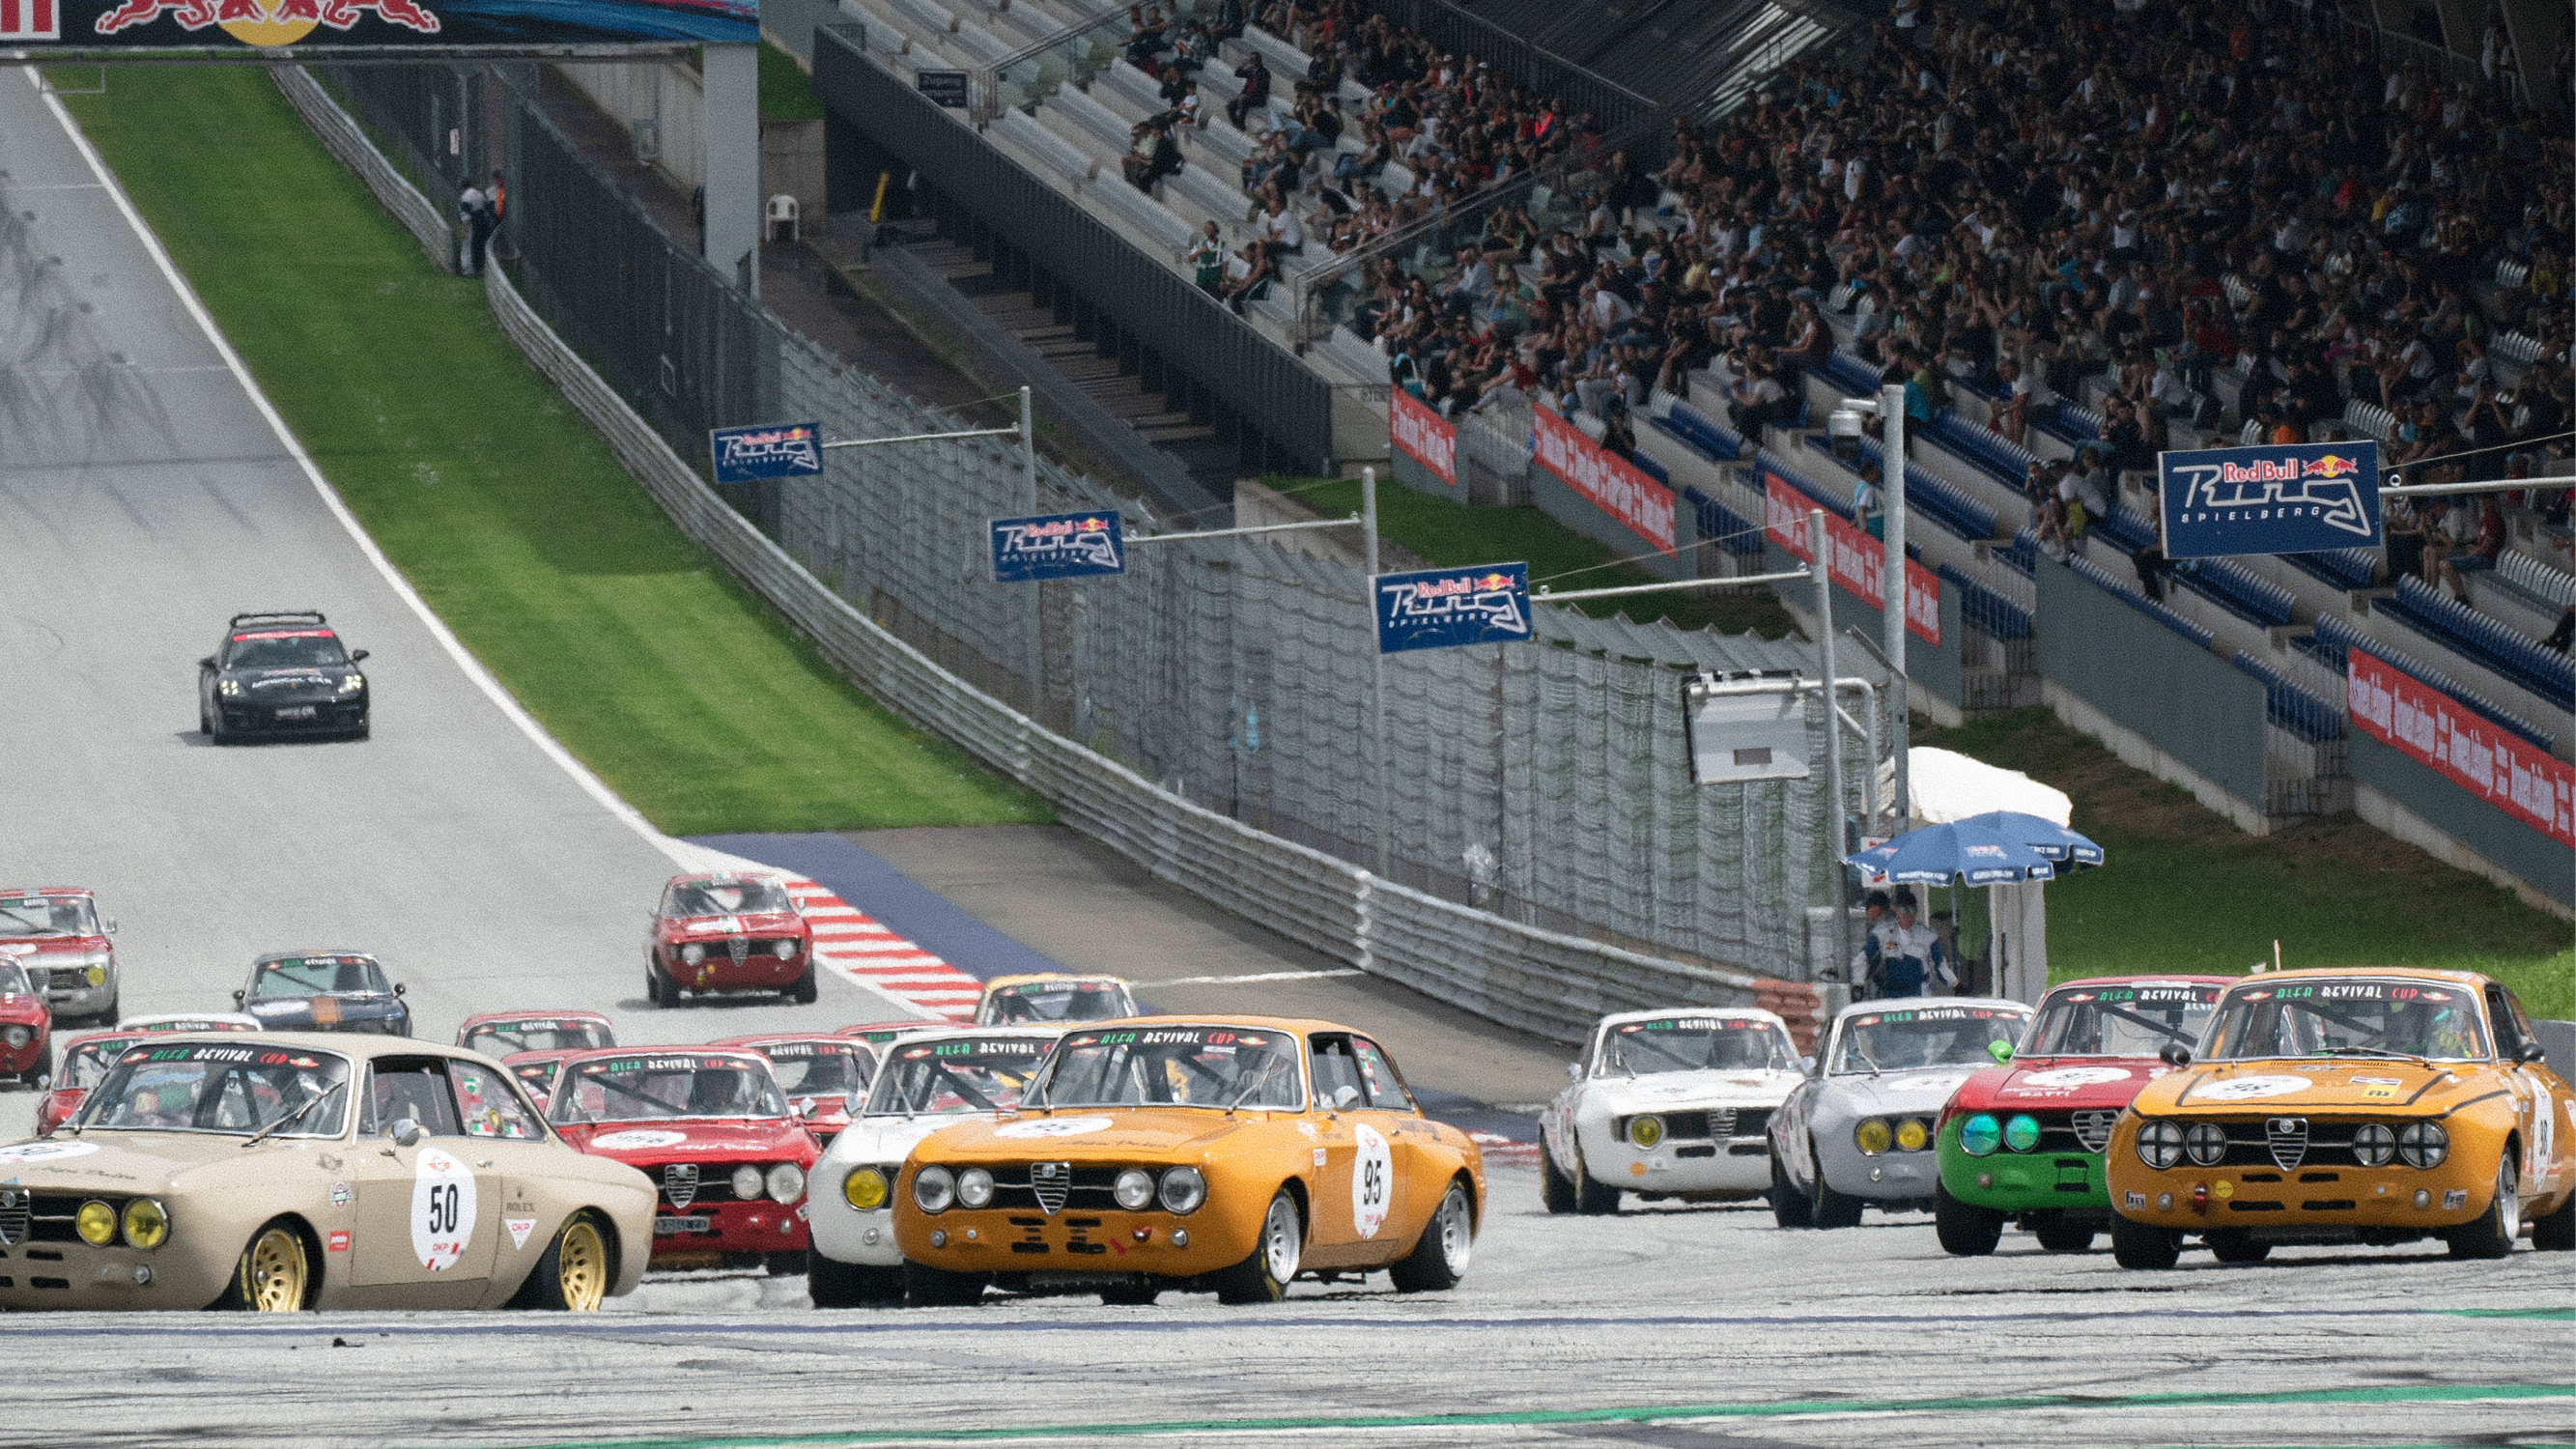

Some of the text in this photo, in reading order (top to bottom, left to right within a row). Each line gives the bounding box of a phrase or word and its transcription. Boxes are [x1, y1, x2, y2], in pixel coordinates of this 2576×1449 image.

[2223, 458, 2298, 483] Red Bull
[2172, 464, 2371, 537] Ring
[2181, 506, 2320, 524] SPIELBERG
[1418, 577, 1472, 598] Red Bull
[2099, 990, 2134, 1002] ALFA
[2140, 989, 2197, 1002] REVIVAL
[2276, 985, 2419, 1000] ALFA REVIVAL CUP
[1918, 1009, 1967, 1020] REVIVAL
[1972, 1010, 1993, 1019] CUP
[1679, 1019, 1723, 1030] REVIVAL
[1100, 1032, 1235, 1045] ALFA REVIVAL CUP
[936, 1043, 971, 1055] ALFA
[978, 1041, 1035, 1054] REVIVAL
[151, 1048, 288, 1065] ALFA REVIVAL CUP
[610, 1059, 724, 1072] ALFA REVIVAL CUP
[1364, 1159, 1381, 1206] 95
[430, 1184, 458, 1234] 50
[506, 1202, 535, 1211] ROLEX
